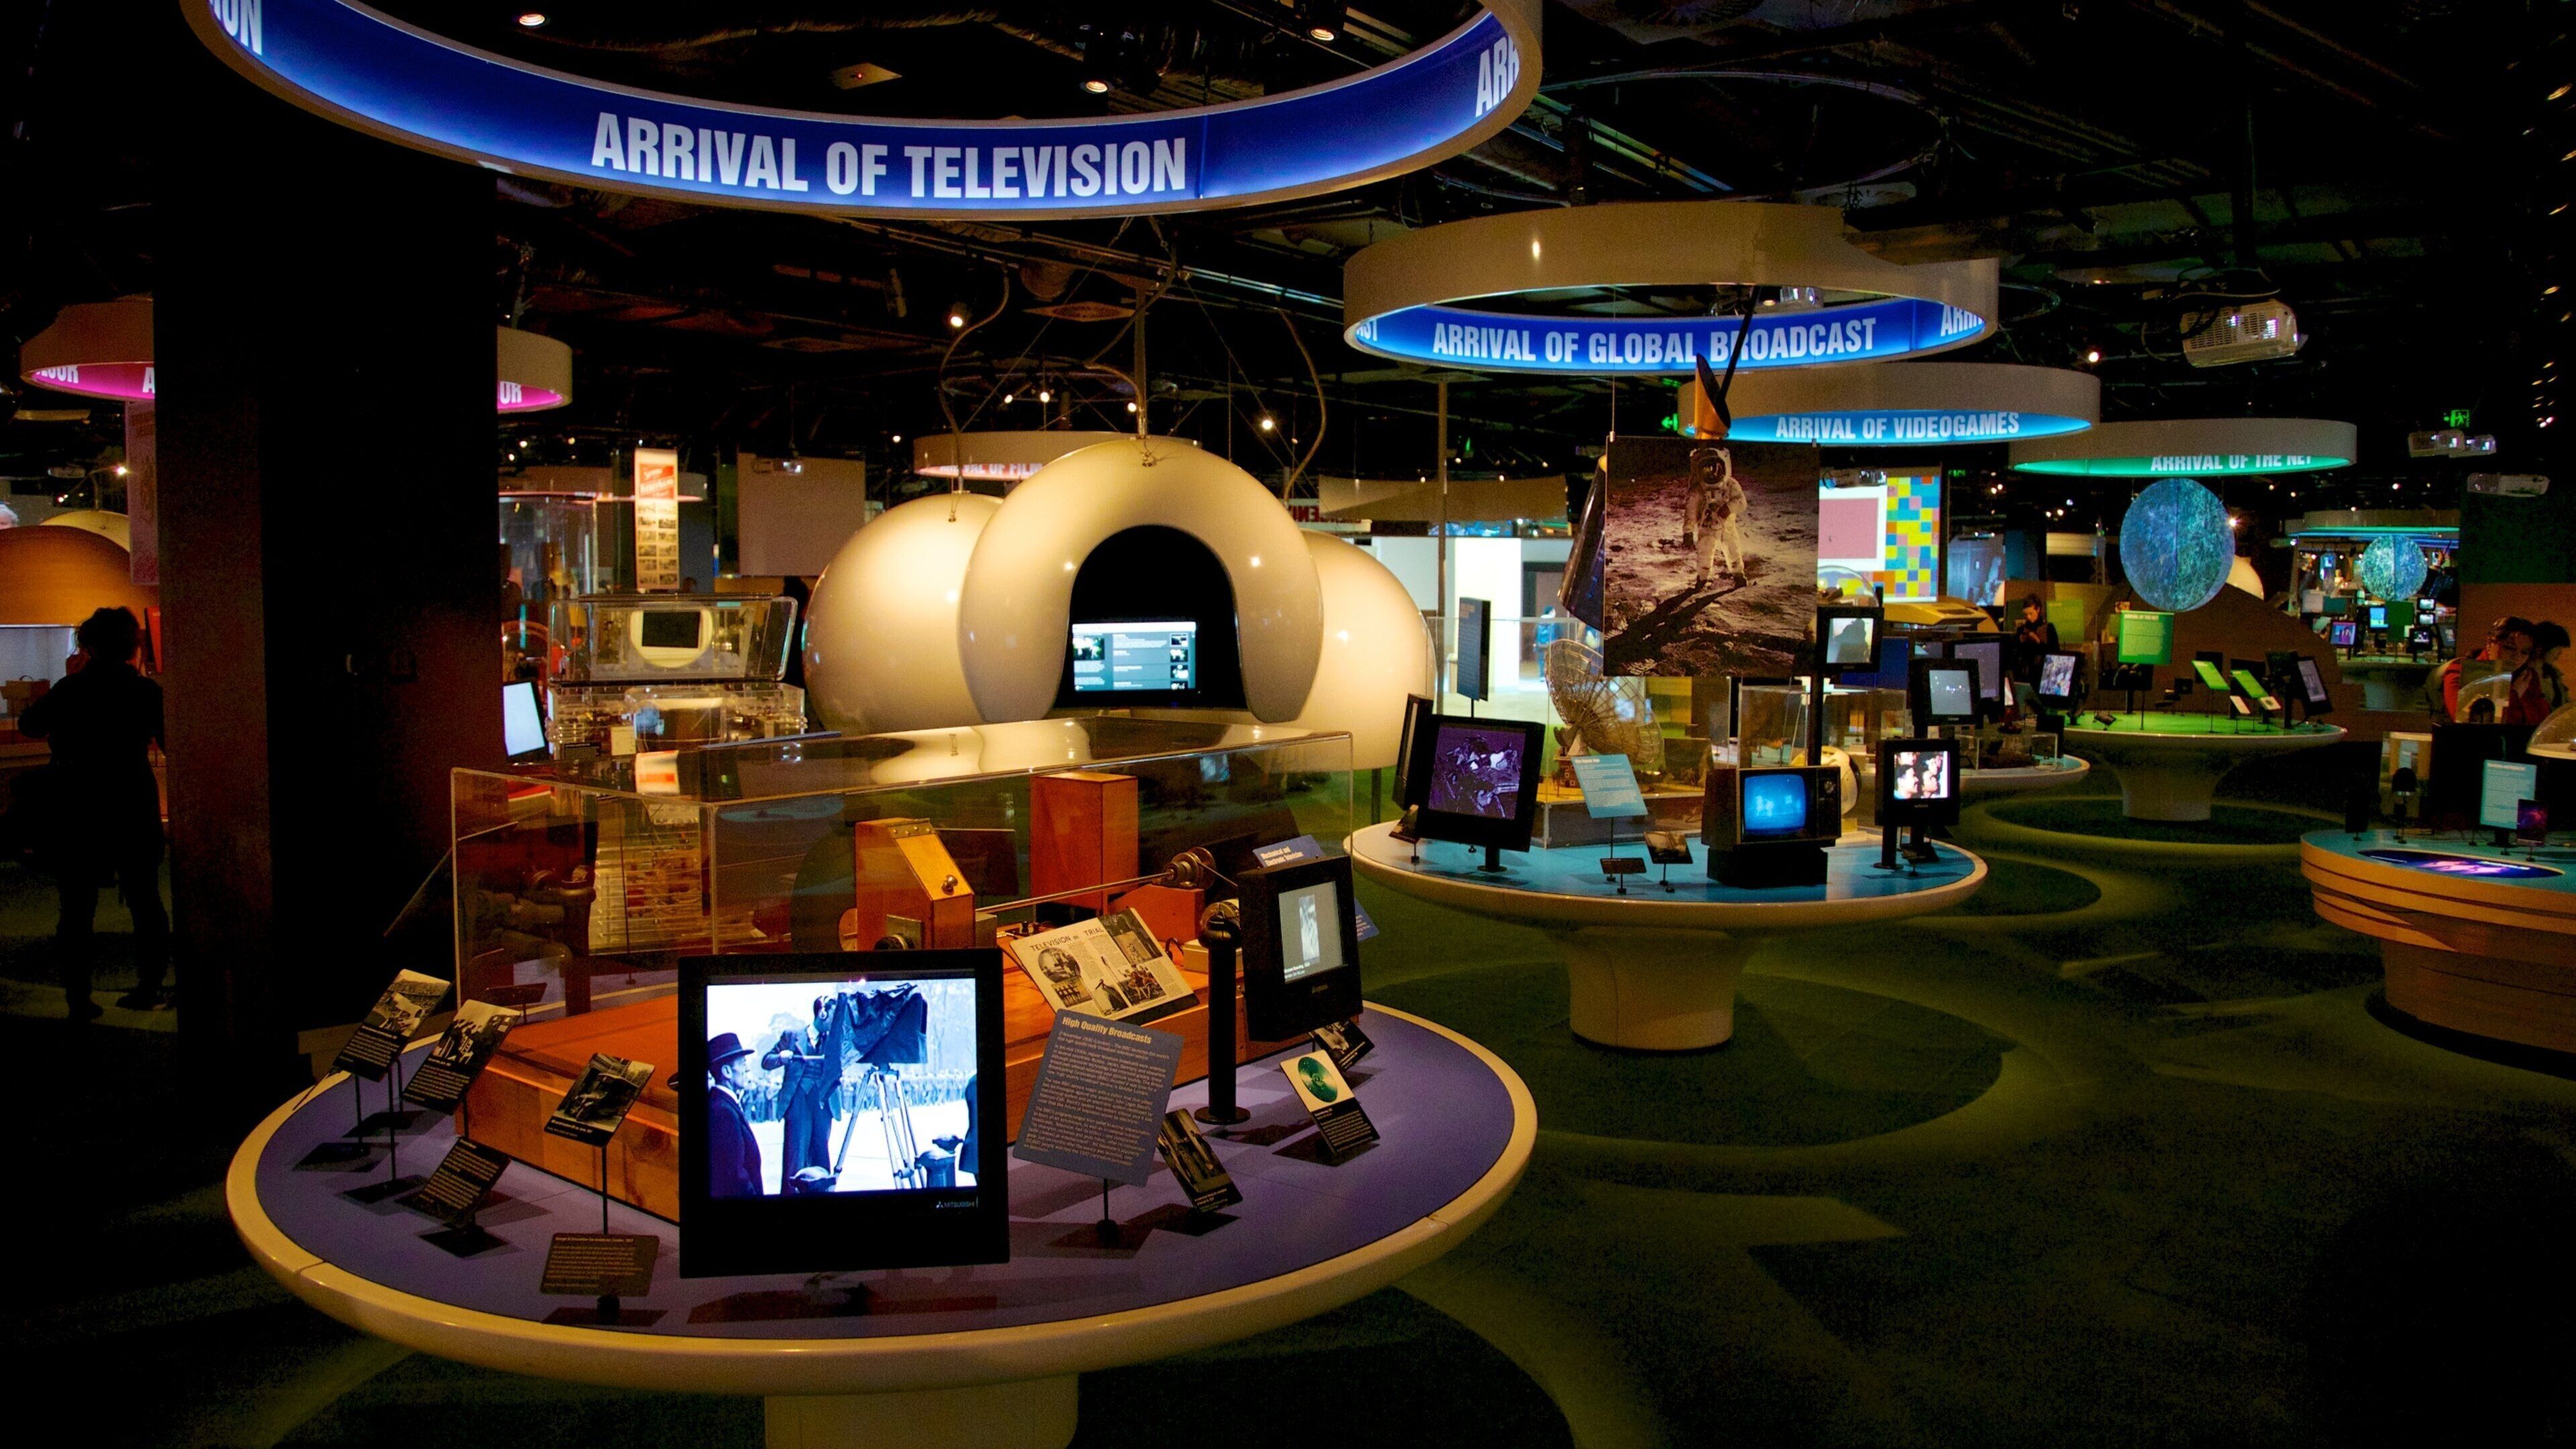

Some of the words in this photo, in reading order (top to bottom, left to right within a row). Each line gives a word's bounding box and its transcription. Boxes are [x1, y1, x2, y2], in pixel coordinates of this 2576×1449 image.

[592, 112, 808, 192] ARRIVAL
[826, 142, 888, 195] OF
[905, 137, 1185, 199] TELEVISION
[1433, 323, 1536, 362] ARRIVAL
[1546, 331, 1578, 362] OF
[1589, 331, 1697, 365] GLOBAL
[1710, 318, 1877, 363] BROADCAST
[1776, 417, 1856, 439] ARRIVAL
[1862, 417, 1886, 439] OF
[1893, 412, 2019, 439] VIDEOGAMES
[2151, 455, 2223, 472] ARRIVAL
[2229, 454, 2248, 469] OF
[2255, 455, 2282, 468] THE
[1030, 936, 1071, 951] TELEVISION
[1083, 927, 1105, 936] TRIAL
[1063, 1016, 1080, 1029] High
[1081, 1020, 1108, 1034] Quality
[1108, 1027, 1152, 1044] Broadcasts
